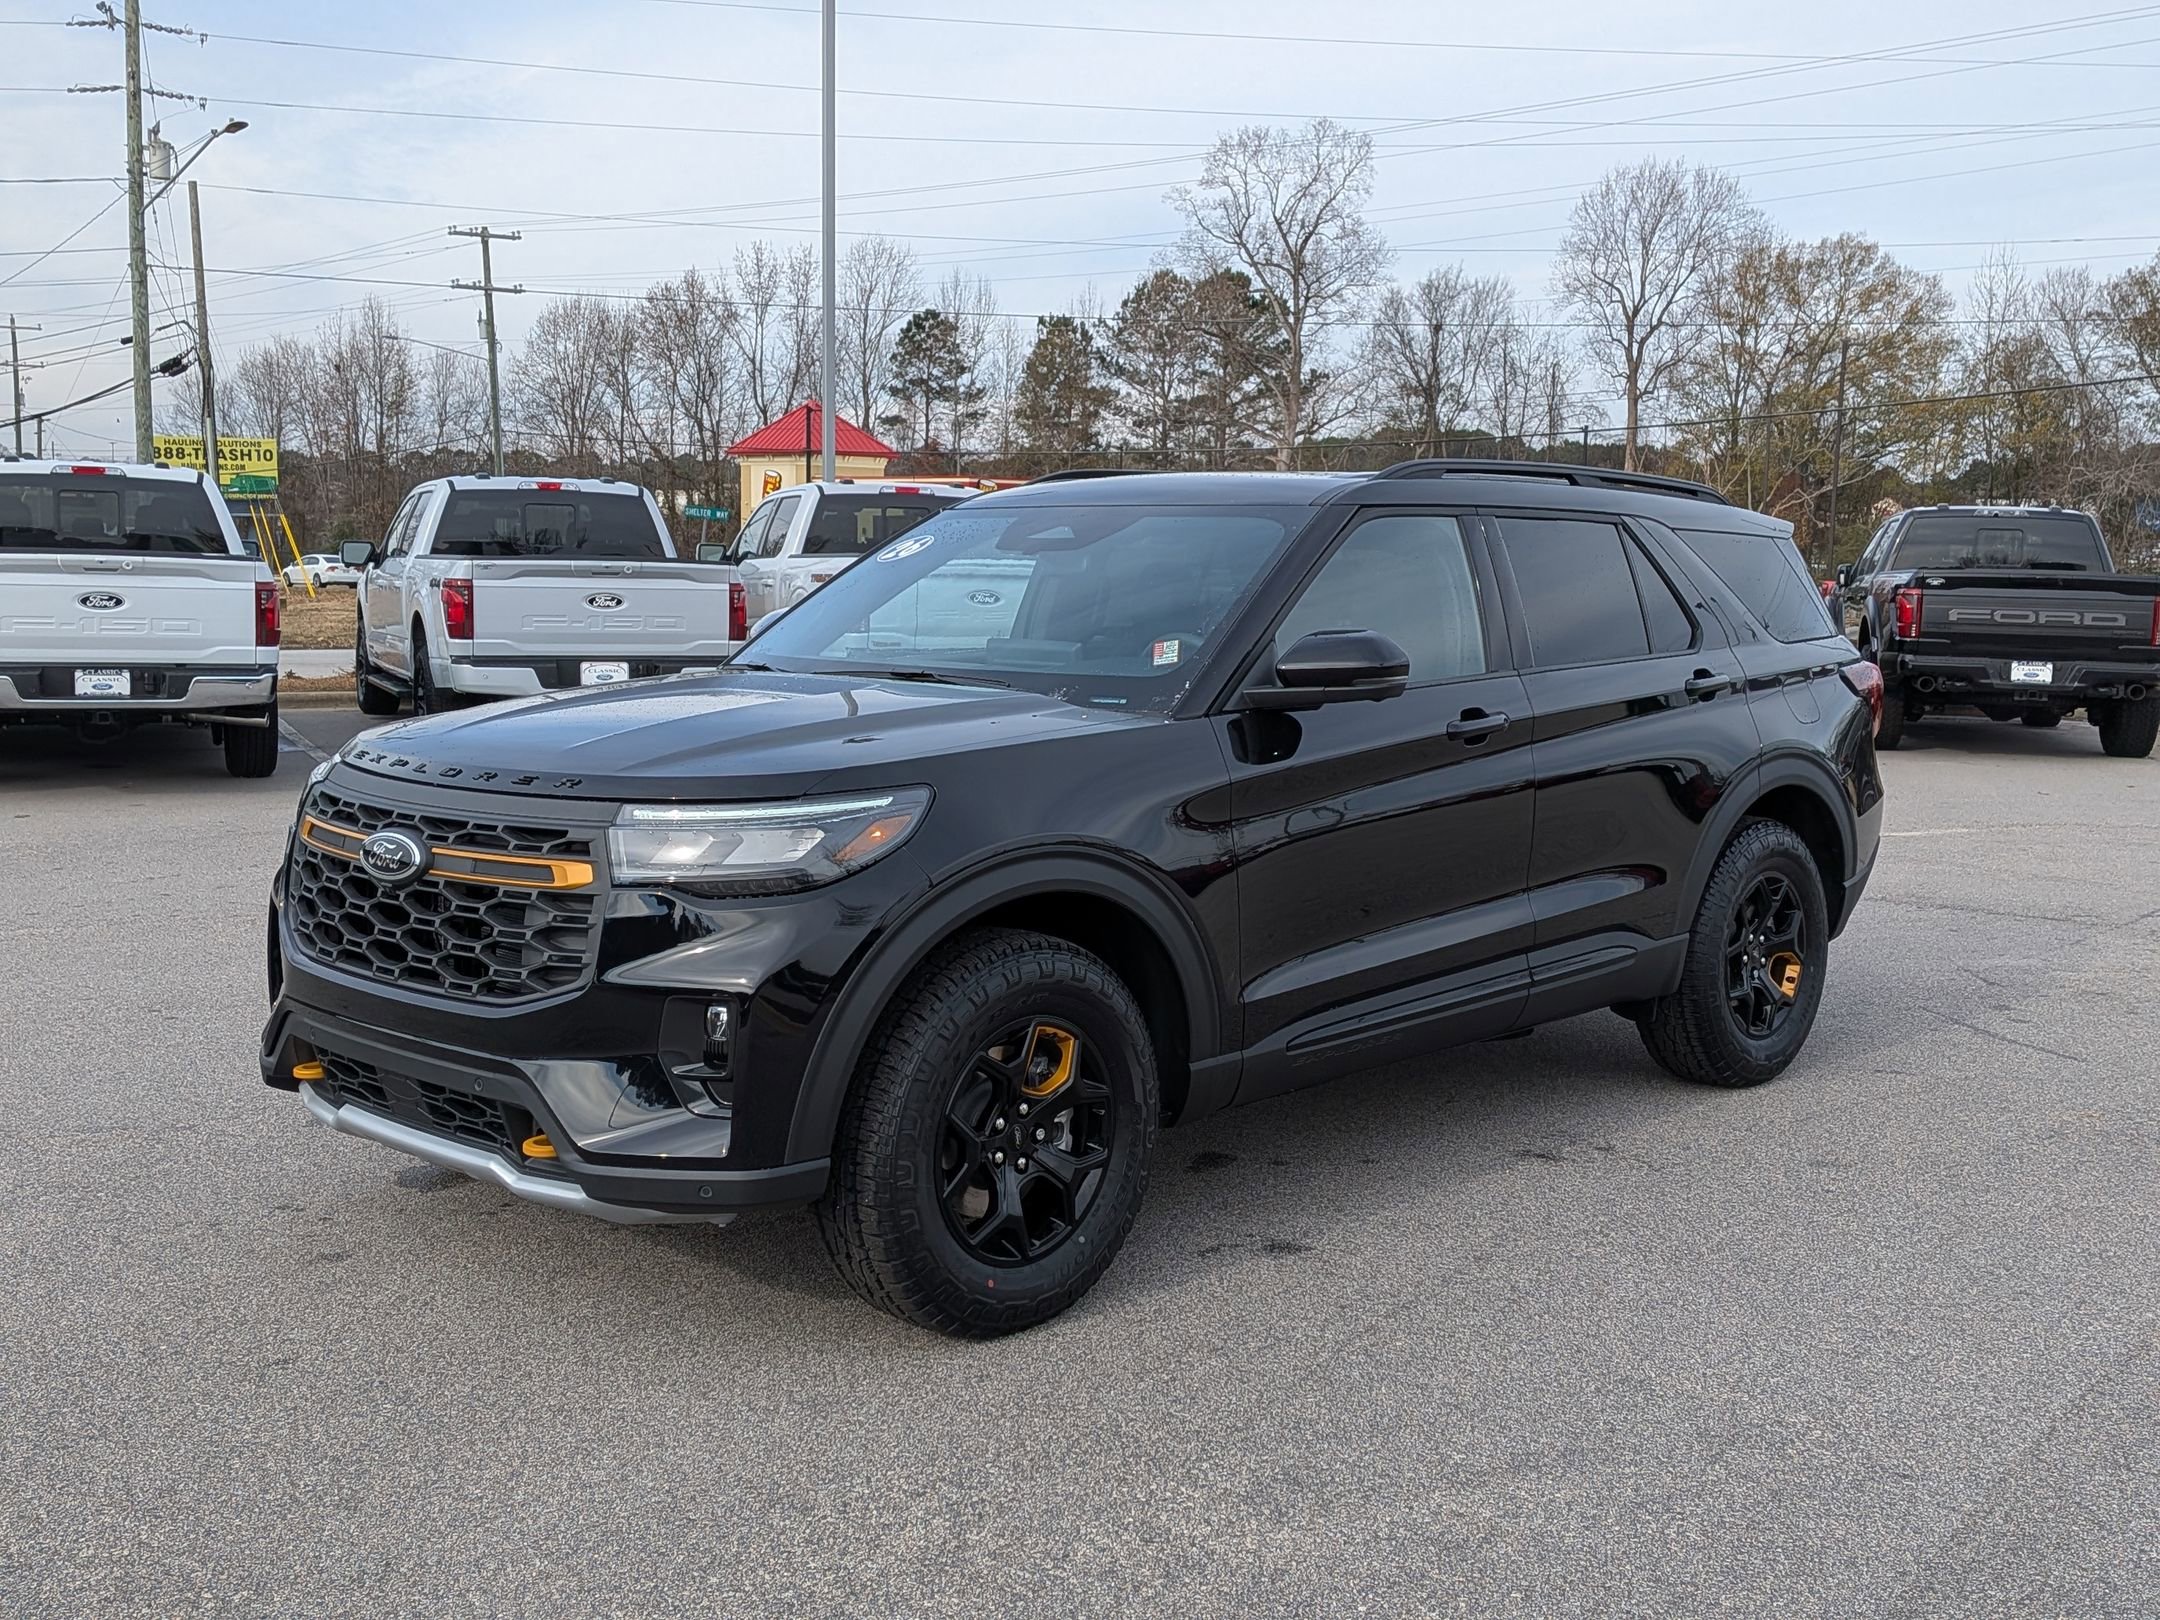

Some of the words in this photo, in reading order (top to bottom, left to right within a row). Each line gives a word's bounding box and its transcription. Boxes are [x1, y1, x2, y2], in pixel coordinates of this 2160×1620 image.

[216, 440, 262, 449] OLUTIONS
[153, 446, 274, 462] 888-TASH10
[685, 507, 711, 517] SHELTER
[716, 511, 729, 519] WAY
[0, 615, 202, 635] F-150
[521, 614, 686, 631] F-150
[1948, 608, 2127, 626] FORD
[352, 749, 585, 789] EXPLORER
[367, 840, 402, 871] Ford
